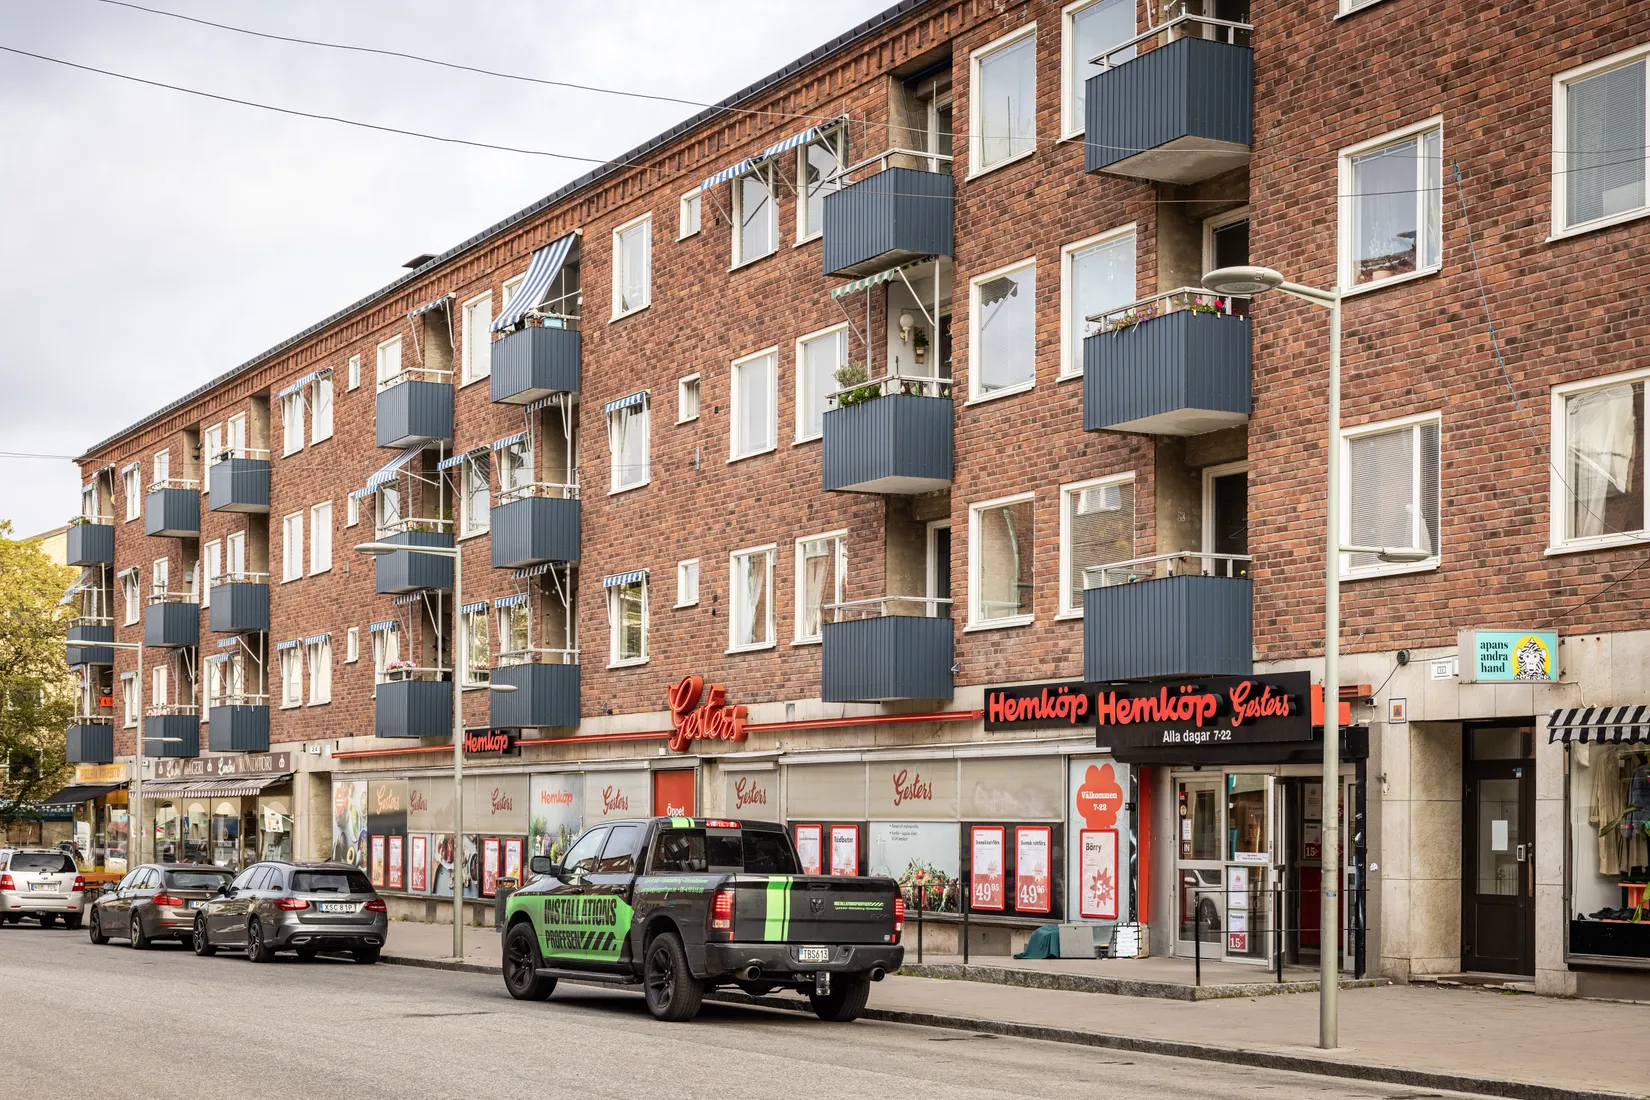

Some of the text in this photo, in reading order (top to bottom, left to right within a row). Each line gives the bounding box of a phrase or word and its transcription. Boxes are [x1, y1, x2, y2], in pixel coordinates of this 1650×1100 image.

[1480, 641, 1509, 651] apans
[1480, 651, 1508, 661] andra
[1481, 662, 1505, 673] hand
[989, 686, 1088, 724] Hemköp
[1097, 680, 1290, 727] Hemköp Gesters
[668, 676, 747, 752] Gesters
[465, 729, 508, 755] Hemköp
[1163, 731, 1180, 743] Alla
[1183, 730, 1210, 744] dagar
[734, 776, 767, 809] Gesters
[893, 769, 933, 806] Gesters
[1081, 791, 1118, 800] Välkommen
[376, 785, 400, 815] Gesters
[409, 789, 428, 815] Gesters
[491, 788, 513, 815] Gesters
[541, 790, 573, 806] Hemköp
[602, 785, 629, 815] Gesters
[1093, 803, 1107, 811] 7-22
[666, 803, 685, 817] Öppet
[975, 883, 991, 901] 49
[1020, 885, 1037, 904] 49
[544, 898, 617, 926] INSTALLATIONS
[545, 930, 582, 950] PROFFSEN
[803, 949, 828, 960] TBS613
